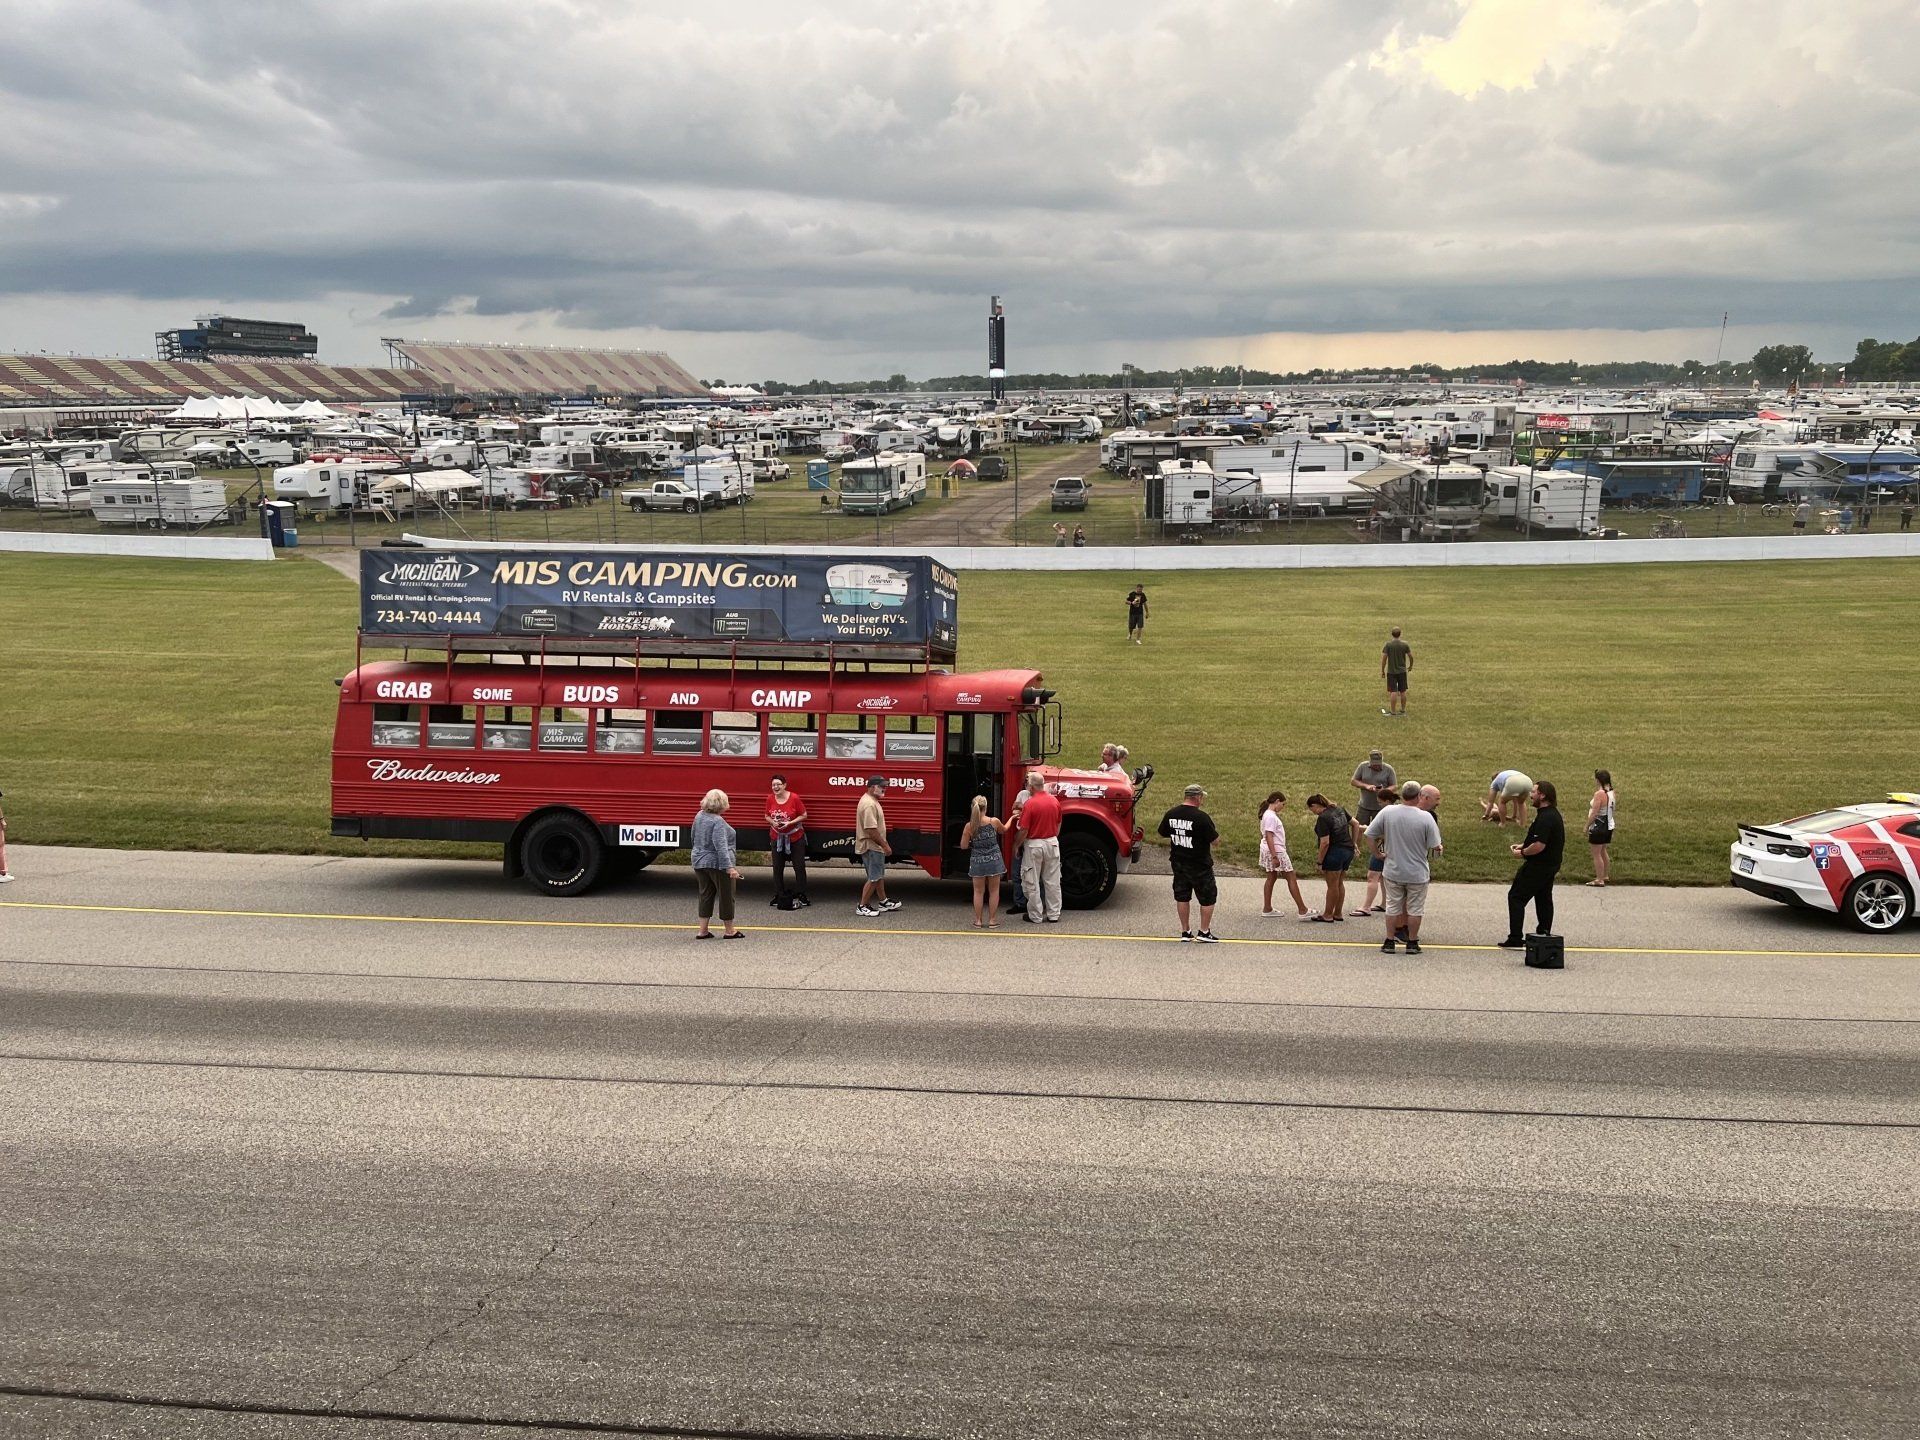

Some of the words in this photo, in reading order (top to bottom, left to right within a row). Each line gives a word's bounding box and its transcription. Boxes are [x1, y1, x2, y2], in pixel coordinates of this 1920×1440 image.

[391, 563, 462, 581] MICHIGAN
[491, 560, 561, 585] MIS
[434, 595, 463, 603] Camping
[562, 591, 580, 602] RV
[583, 591, 632, 603] Rentals
[634, 592, 645, 603] &
[648, 592, 716, 606] Campsites
[377, 610, 482, 624] 734-740-4444
[822, 614, 838, 623] We
[841, 614, 880, 624] Deliver
[882, 614, 908, 624] RV's.
[597, 623, 649, 631] HORSES
[837, 625, 856, 634] You
[858, 625, 893, 636] Enjoy.
[376, 680, 433, 699] GRAB
[472, 687, 513, 701] SOME
[563, 685, 619, 703] BUDS
[669, 692, 700, 705] AND
[751, 689, 812, 708] CAMP
[431, 732, 470, 740] Budweiser
[546, 728, 563, 736] MIS
[543, 735, 584, 743] CAMPING
[656, 737, 697, 745] Budweiser
[775, 738, 793, 746] MIS
[772, 745, 814, 753] CAMPING
[888, 742, 930, 751] Budweiser
[366, 759, 500, 784] Budweiser
[828, 776, 865, 786] GRAB
[889, 777, 925, 788] BUDS
[1169, 819, 1193, 830] FRANK
[622, 828, 661, 842] Mobil
[1170, 834, 1193, 848] TANK
